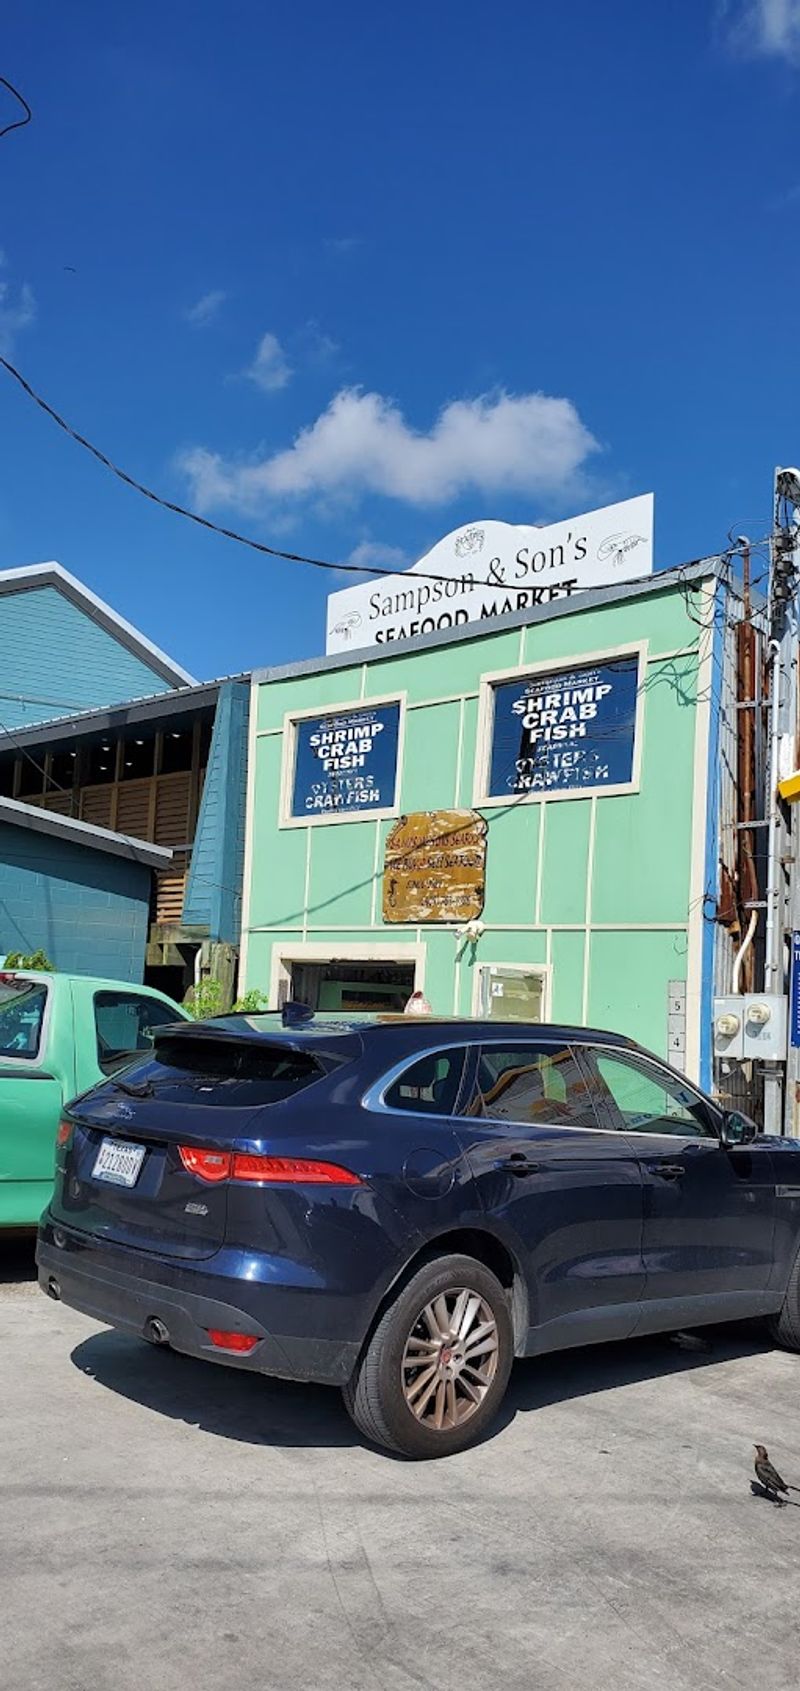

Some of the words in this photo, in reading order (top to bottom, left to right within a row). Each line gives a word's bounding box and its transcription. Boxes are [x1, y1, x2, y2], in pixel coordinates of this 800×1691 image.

[369, 571, 474, 620] Sampson
[487, 557, 506, 585] &
[515, 533, 587, 579] Son's
[375, 609, 469, 644] SEAFOOD
[480, 579, 578, 620] MARKET
[511, 684, 613, 714] SHRIMP
[522, 703, 598, 729] CRAB
[309, 723, 384, 746] SHRIMP
[530, 722, 587, 744] FISH
[318, 739, 372, 759] CRAB
[323, 755, 365, 771] FISH
[674, 1000, 681, 1011] 5
[673, 1037, 680, 1048] 4
